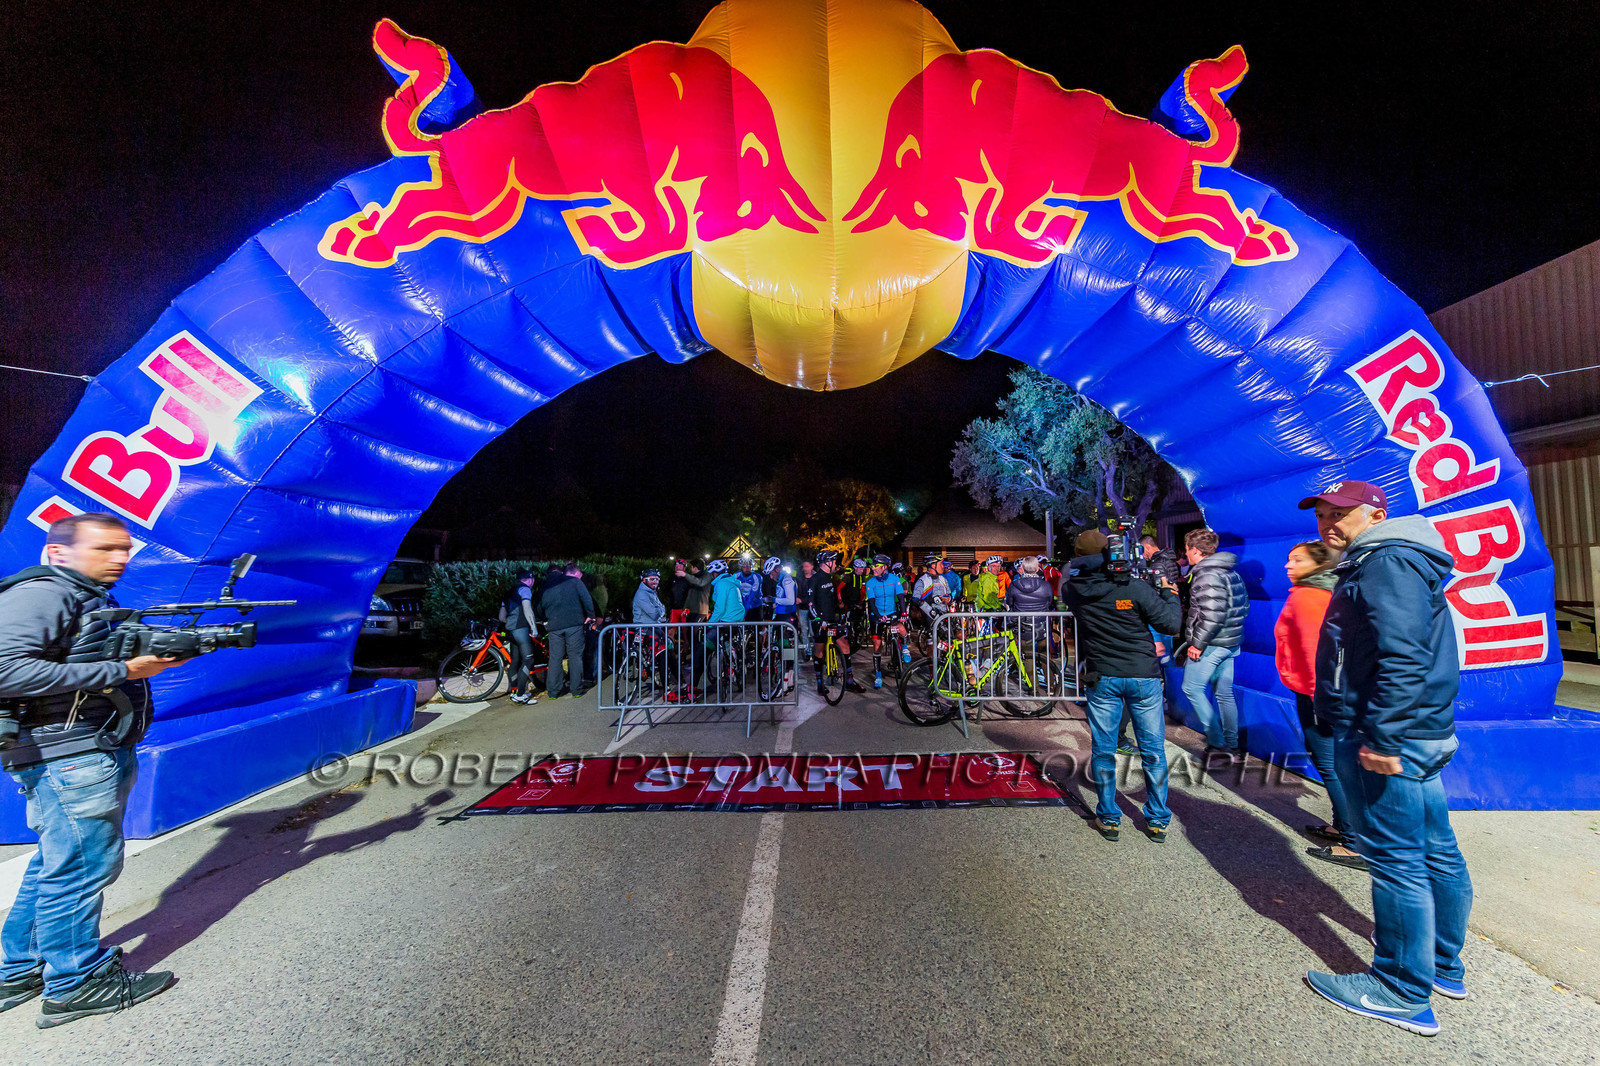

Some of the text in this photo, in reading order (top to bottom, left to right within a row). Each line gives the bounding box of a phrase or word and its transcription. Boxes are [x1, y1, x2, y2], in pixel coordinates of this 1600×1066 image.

[62, 330, 264, 530] Bull
[1345, 329, 1549, 671] Red Bull
[633, 762, 914, 793] START
